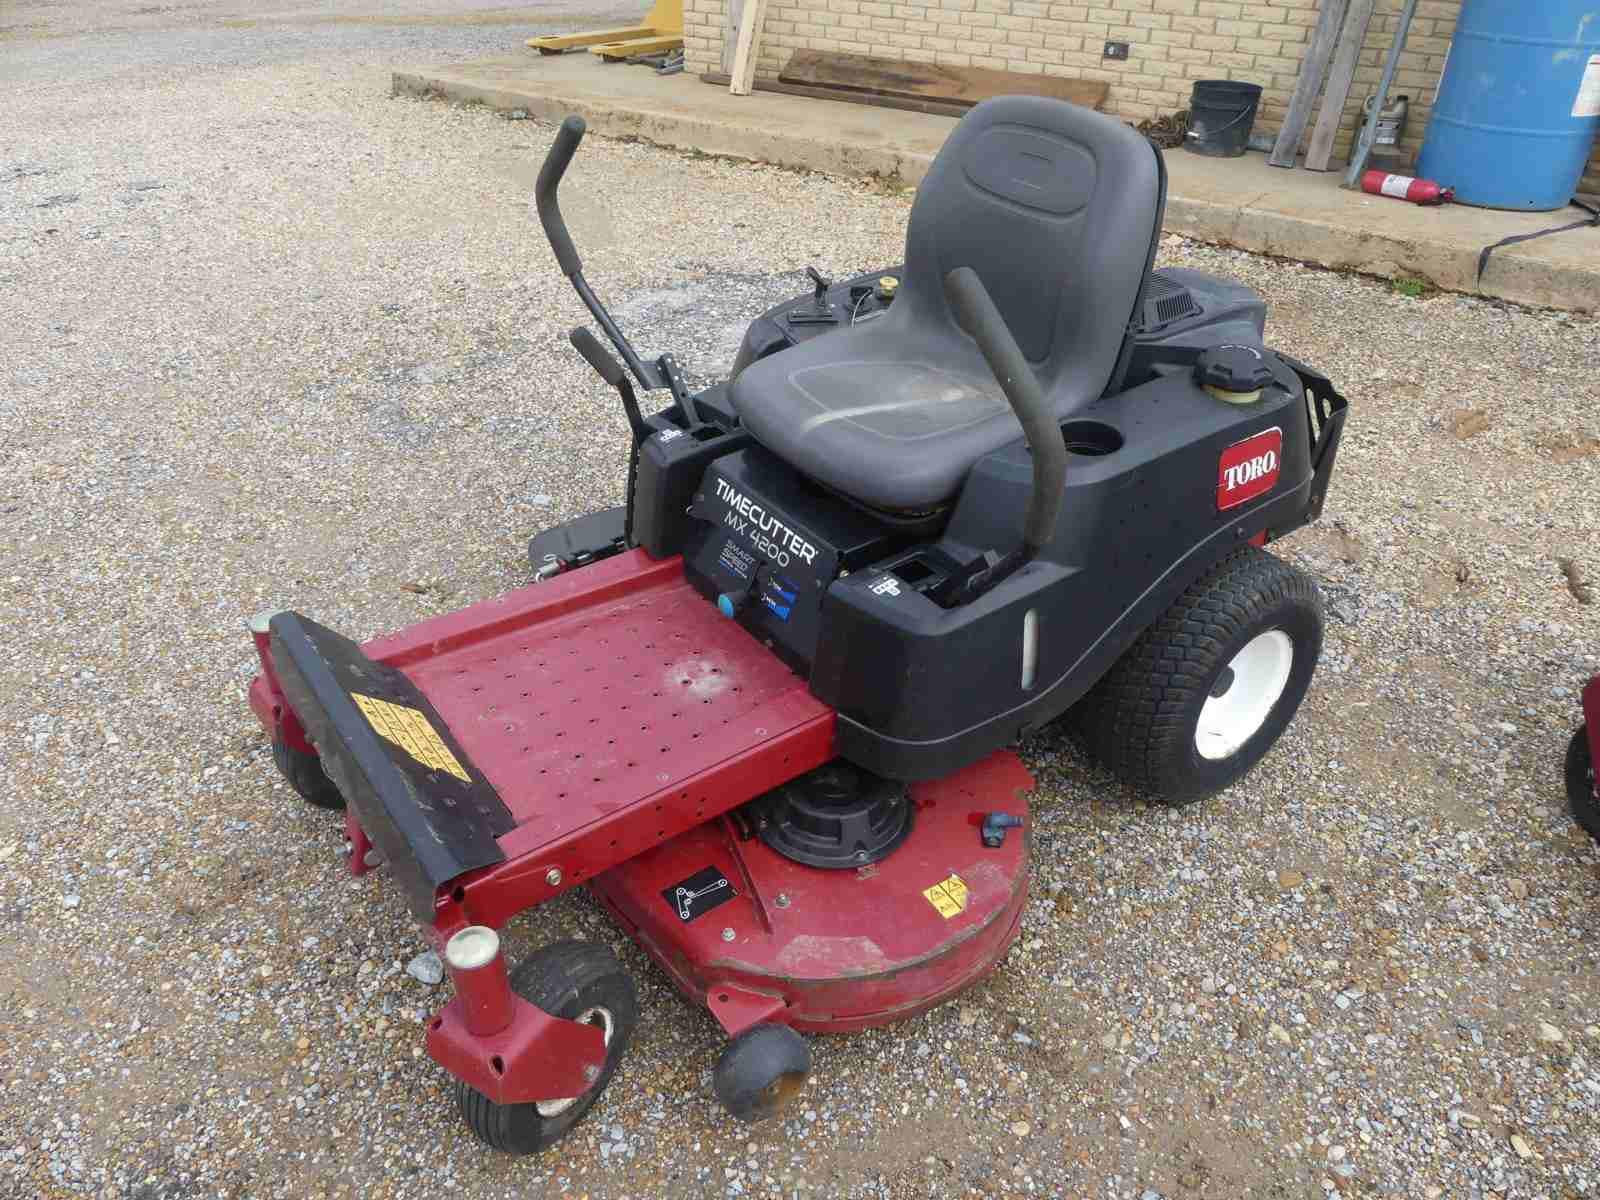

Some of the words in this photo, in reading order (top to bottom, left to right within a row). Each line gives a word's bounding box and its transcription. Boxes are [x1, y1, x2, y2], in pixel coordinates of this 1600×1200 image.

[1224, 450, 1276, 491] TORO
[716, 478, 817, 566] TIMECUTTER
[724, 511, 748, 536] MX
[750, 530, 790, 567] 4200
